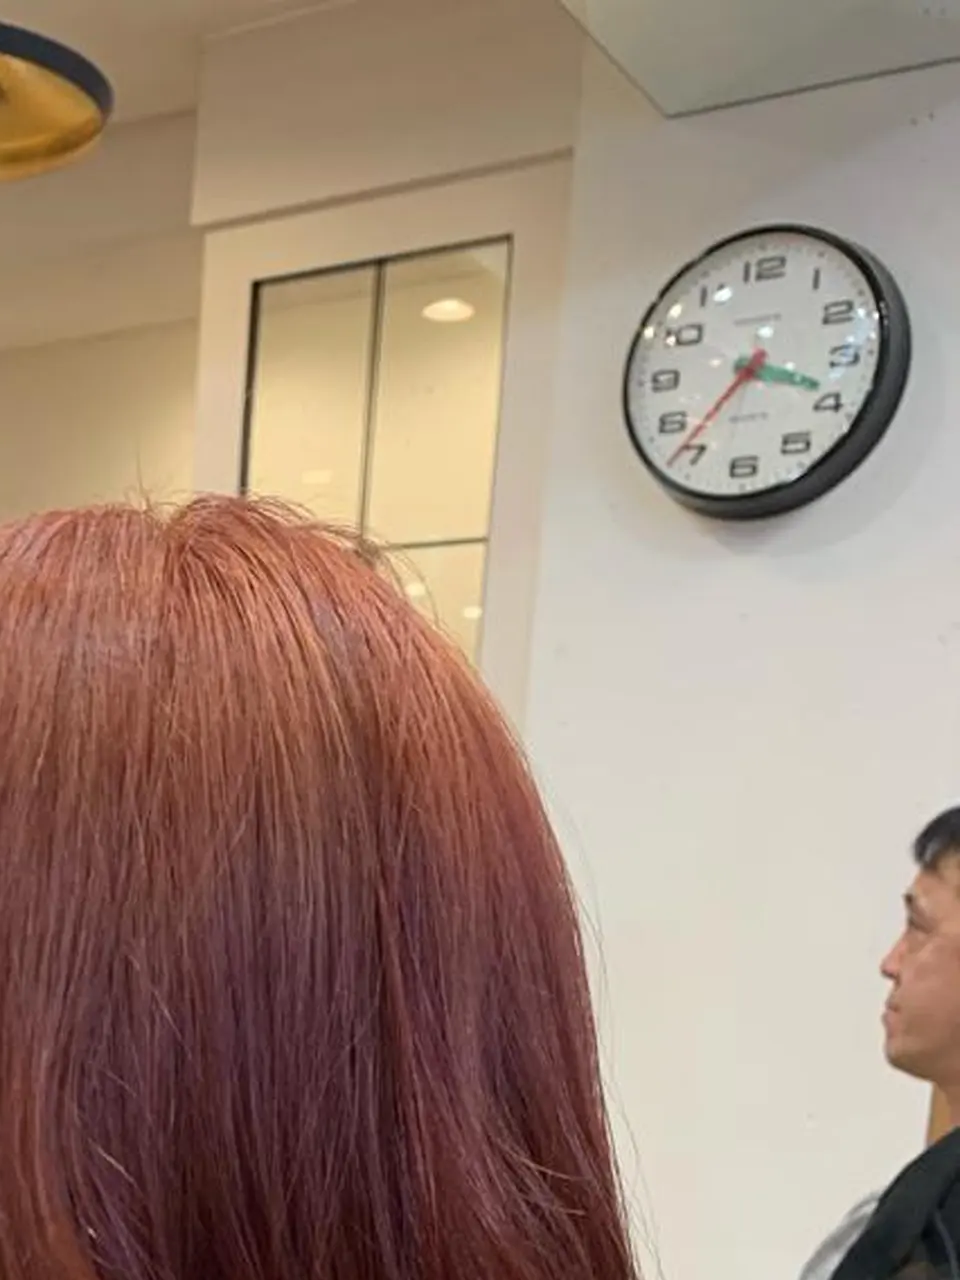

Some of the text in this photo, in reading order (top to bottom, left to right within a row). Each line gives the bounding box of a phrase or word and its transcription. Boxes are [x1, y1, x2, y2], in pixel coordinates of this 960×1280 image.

[743, 256, 786, 283] 12
[812, 267, 820, 291] 1
[822, 300, 854, 325] 2
[829, 344, 861, 368] 3
[651, 369, 680, 393] 9
[813, 392, 843, 413] 4
[681, 443, 707, 467] 7
[781, 431, 811, 455] 5
[729, 455, 758, 479] 6
